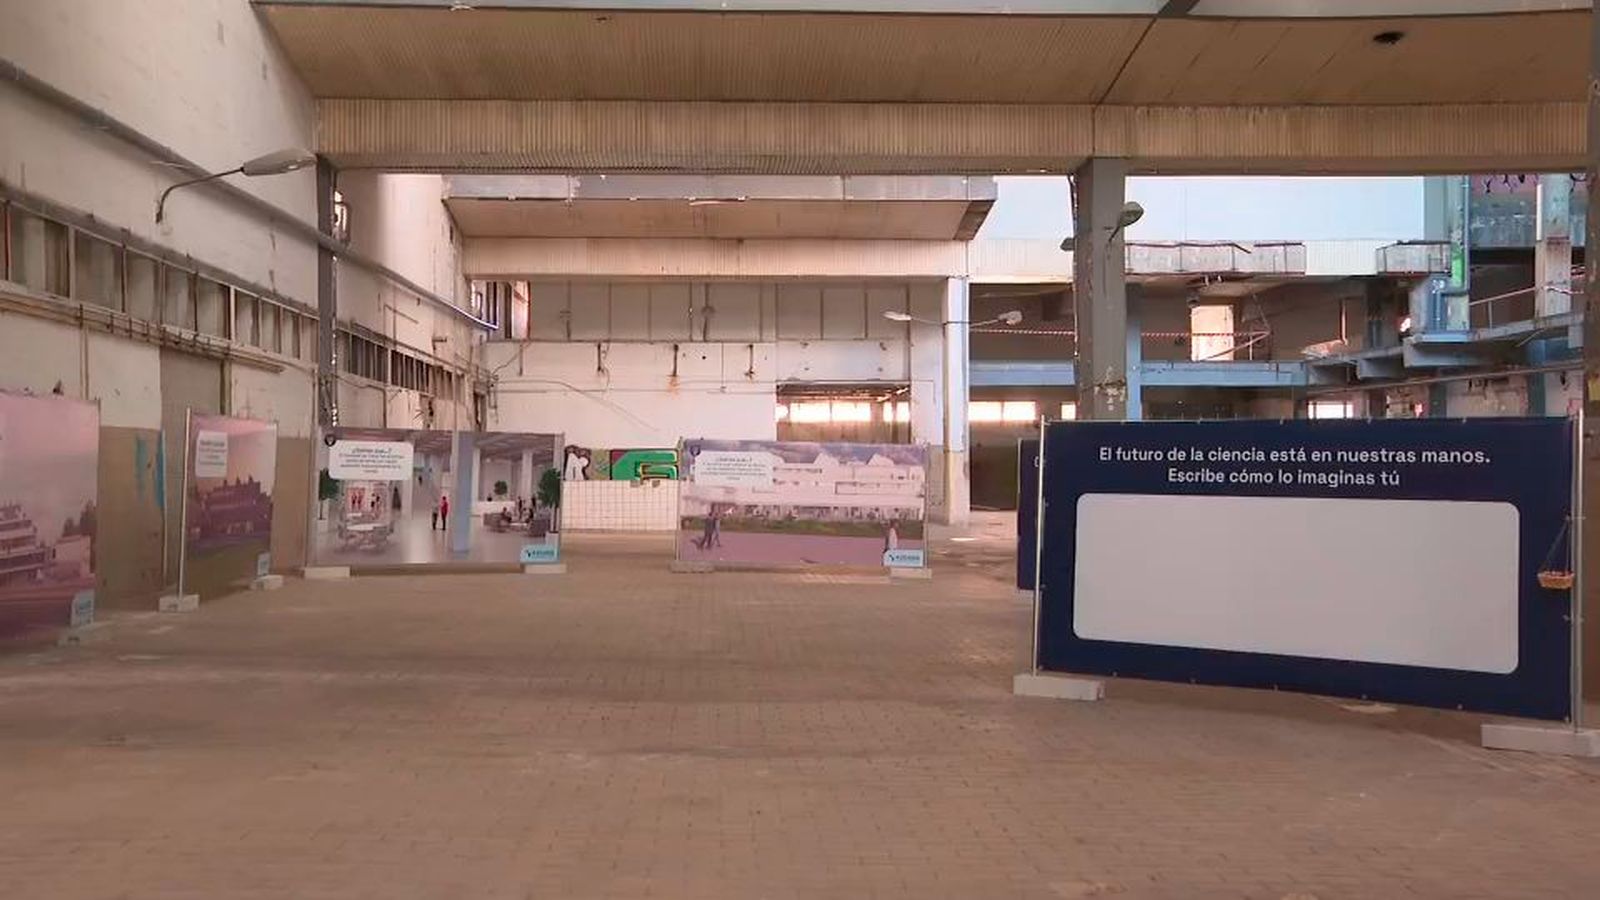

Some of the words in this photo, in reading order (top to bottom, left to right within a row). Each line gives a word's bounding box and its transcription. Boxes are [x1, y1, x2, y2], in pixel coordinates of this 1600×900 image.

[1100, 446, 1112, 461] El
[1116, 446, 1163, 461] futuro
[1168, 447, 1187, 461] de
[1191, 447, 1204, 461] la
[1208, 447, 1265, 462] ciencia
[1270, 447, 1307, 462] está
[1312, 450, 1332, 463] en
[1337, 448, 1416, 463] nuestras
[1422, 450, 1490, 464] manos.
[1168, 468, 1224, 483] Escribe
[1229, 469, 1273, 484] cómo
[1279, 469, 1293, 484] lo
[1298, 469, 1375, 488] imaginas
[1380, 470, 1399, 486] tú
